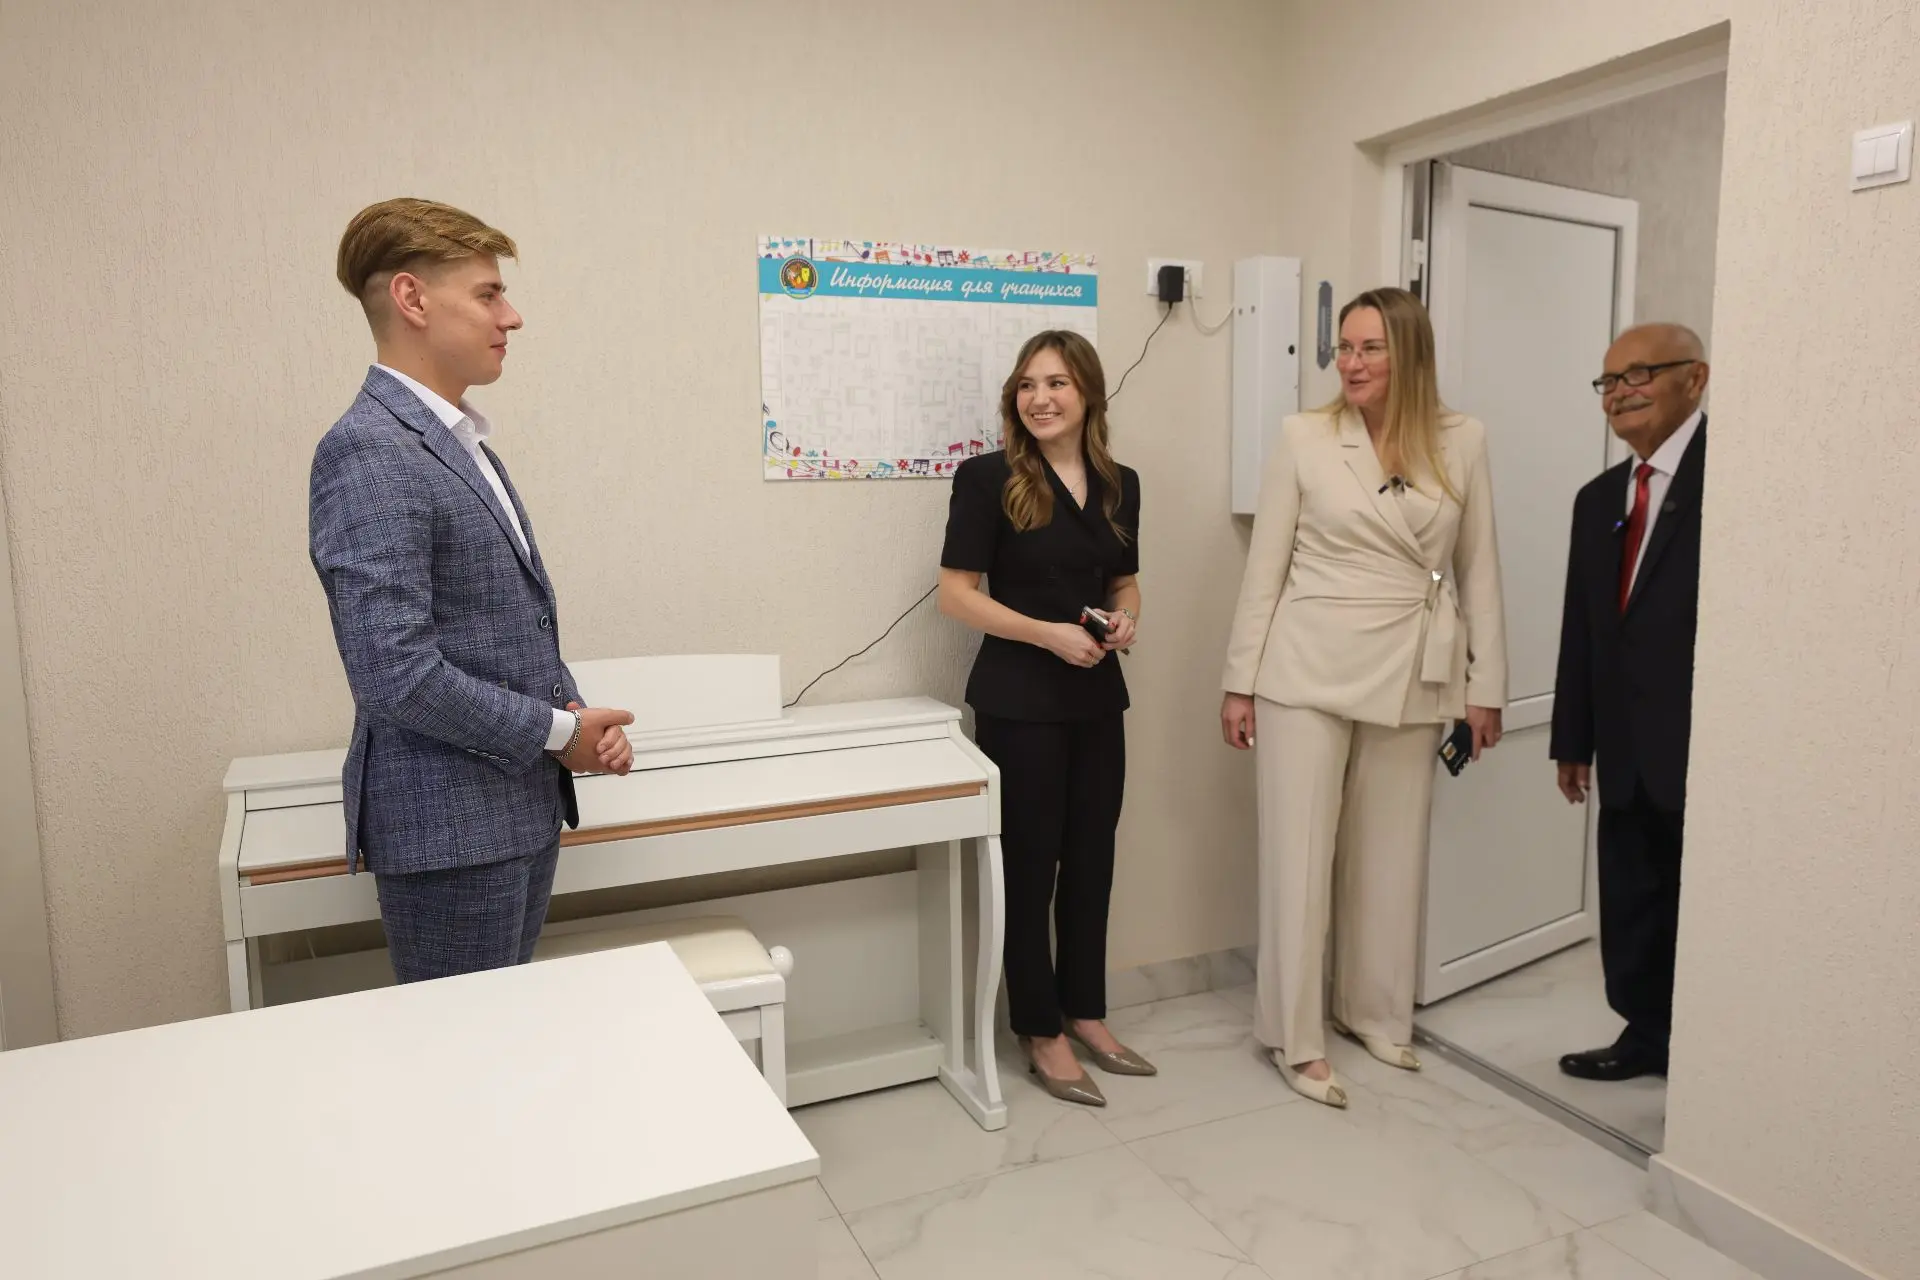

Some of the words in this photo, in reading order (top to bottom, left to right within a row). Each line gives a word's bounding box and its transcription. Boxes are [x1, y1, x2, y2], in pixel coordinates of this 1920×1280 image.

[830, 266, 953, 295] Информация
[961, 280, 993, 298] для
[1000, 282, 1083, 300] учащихся
